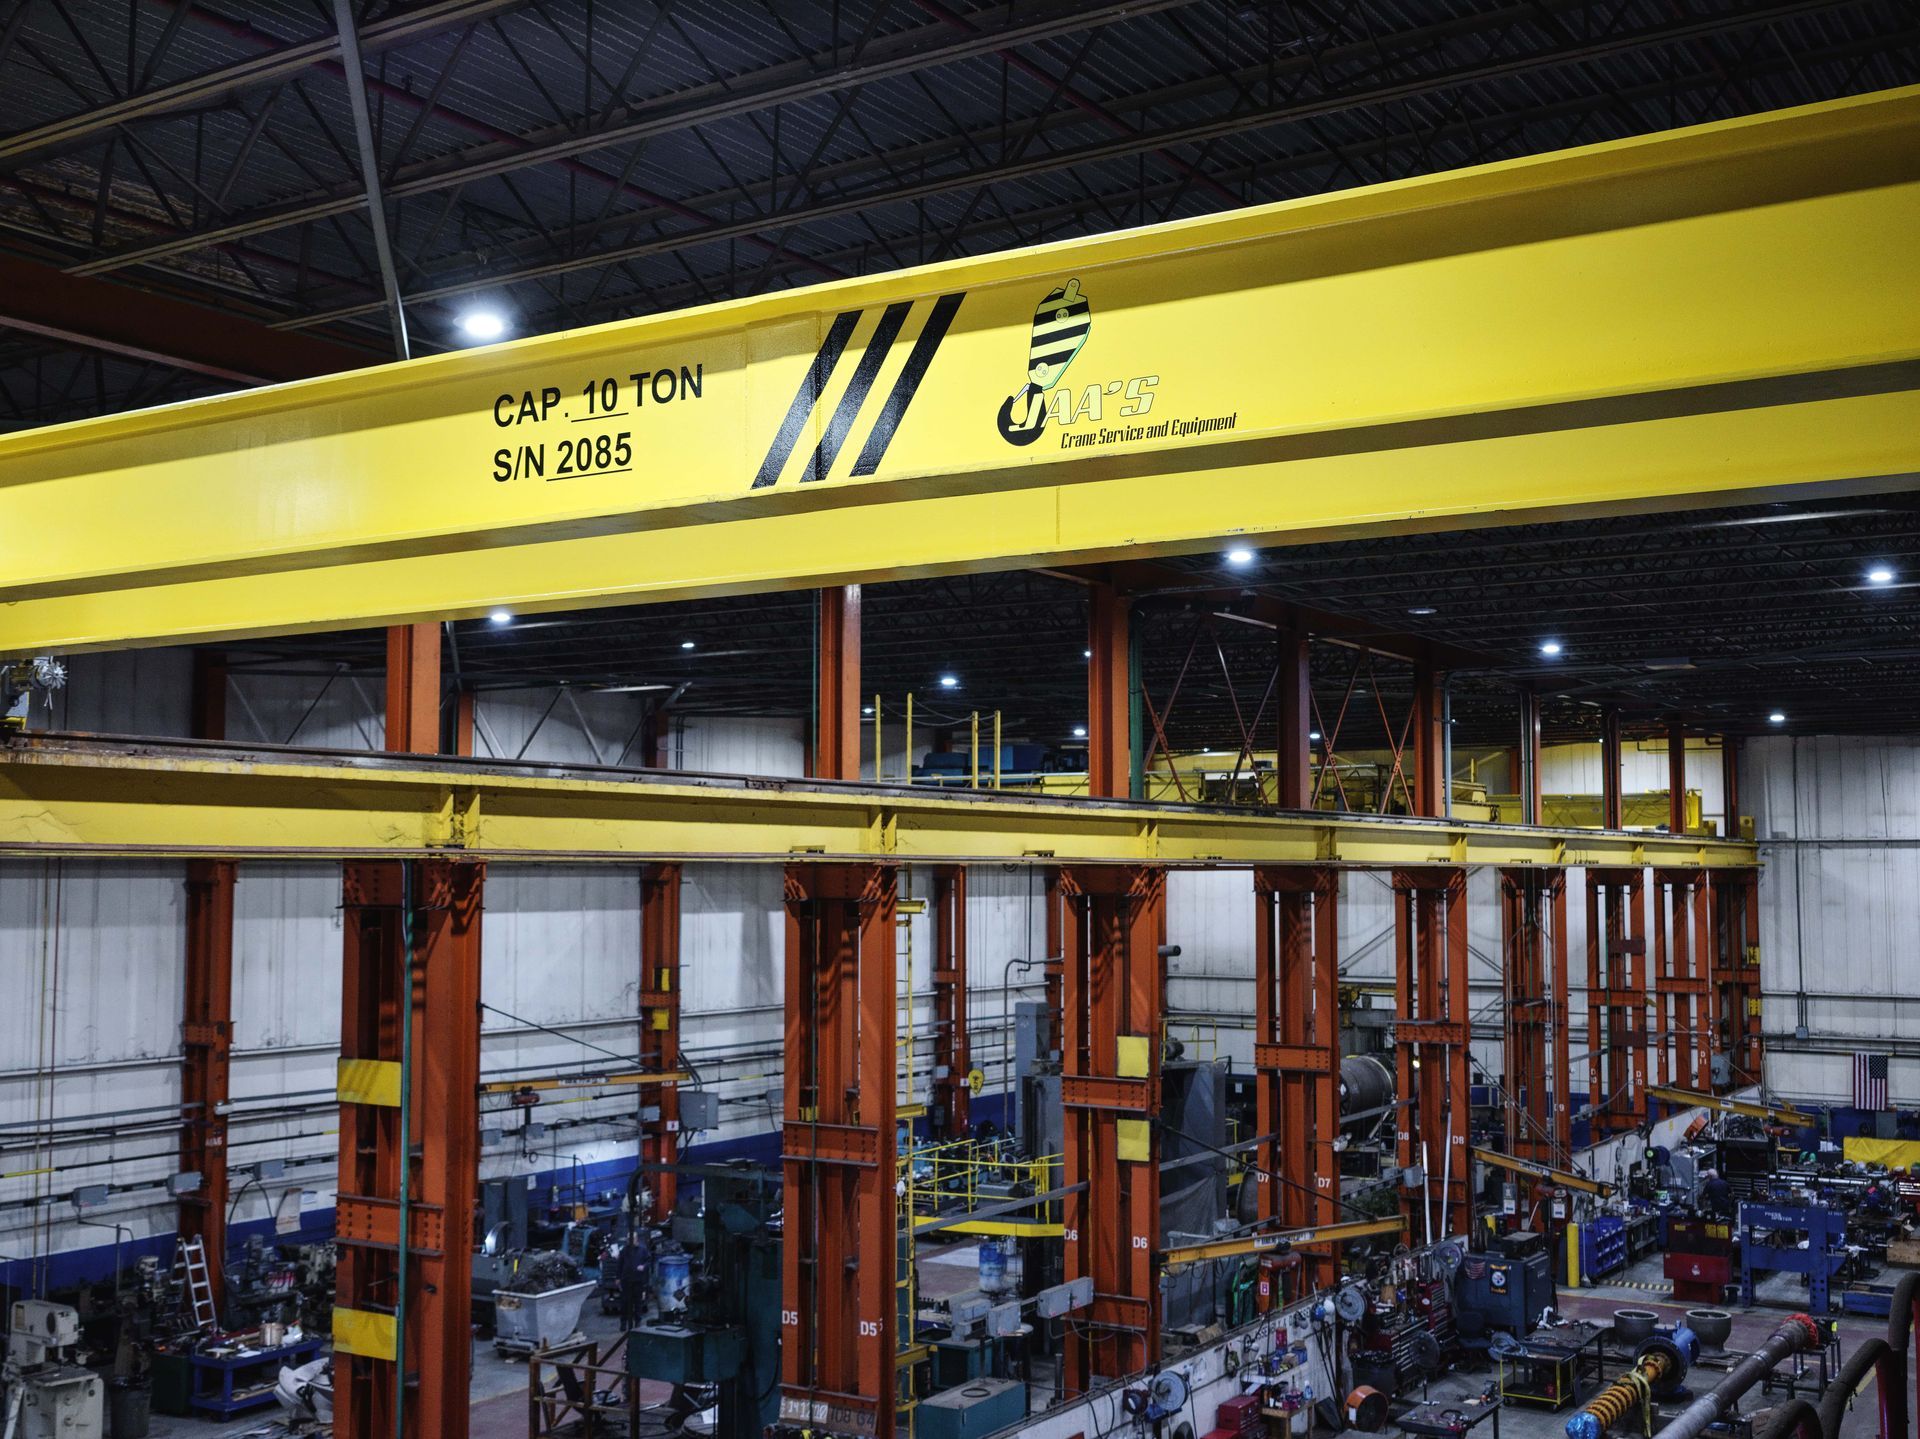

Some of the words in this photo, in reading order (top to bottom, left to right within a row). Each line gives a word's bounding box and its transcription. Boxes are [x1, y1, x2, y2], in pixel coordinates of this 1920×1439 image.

[494, 387, 569, 428] CAP.
[583, 377, 618, 415] 10
[630, 363, 703, 407] TON
[1061, 432, 1097, 449] Crane
[1099, 425, 1147, 445] Service
[1147, 420, 1169, 439] and
[1171, 412, 1238, 436] Equipment
[493, 443, 545, 483] S/N
[556, 432, 632, 475] 2085
[1397, 1131, 1410, 1141] D8
[1452, 1135, 1465, 1145] D8
[1257, 1172, 1270, 1183] D7
[1317, 1177, 1331, 1188] D7
[1064, 1228, 1079, 1241] D6
[1132, 1236, 1148, 1249] D6
[781, 1309, 799, 1326] D5
[860, 1320, 878, 1337] D5
